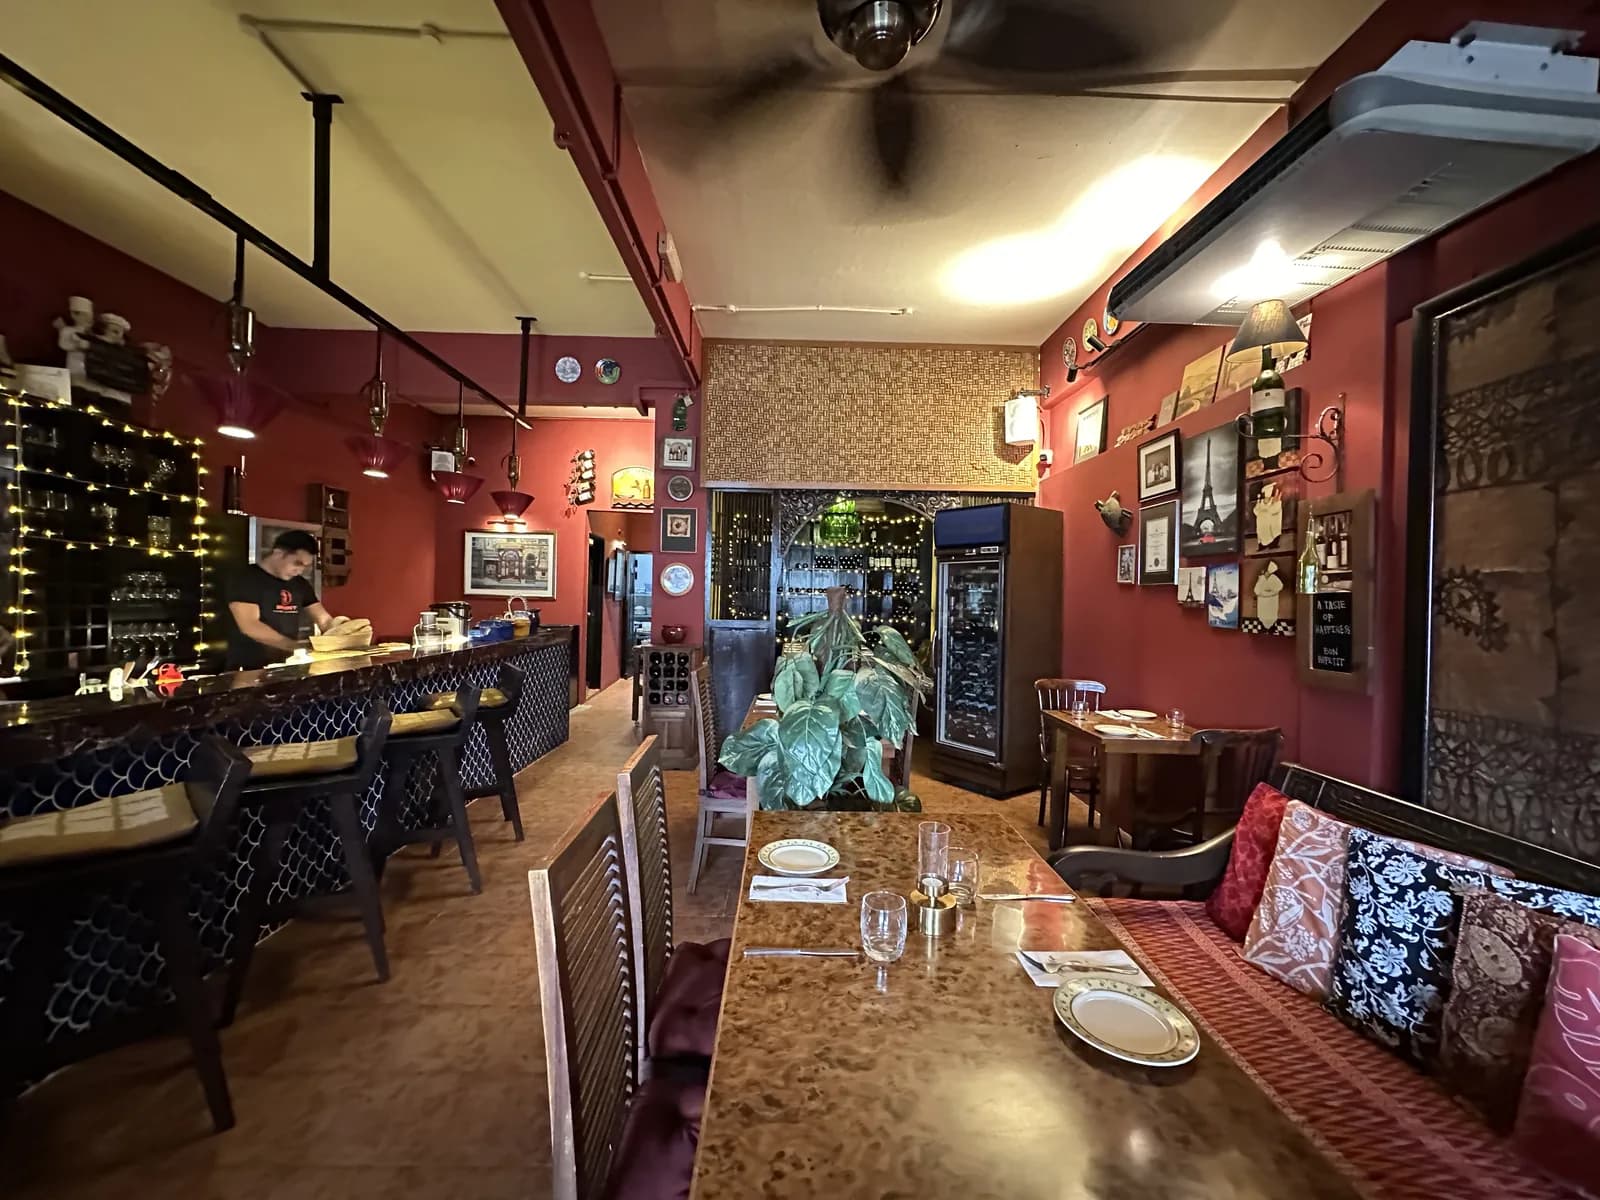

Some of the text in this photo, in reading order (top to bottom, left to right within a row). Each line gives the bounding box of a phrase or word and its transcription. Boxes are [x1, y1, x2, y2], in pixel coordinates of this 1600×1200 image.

[1317, 600, 1347, 610] A TASTE
[1322, 613, 1334, 622] OF
[1323, 647, 1338, 656] BON
